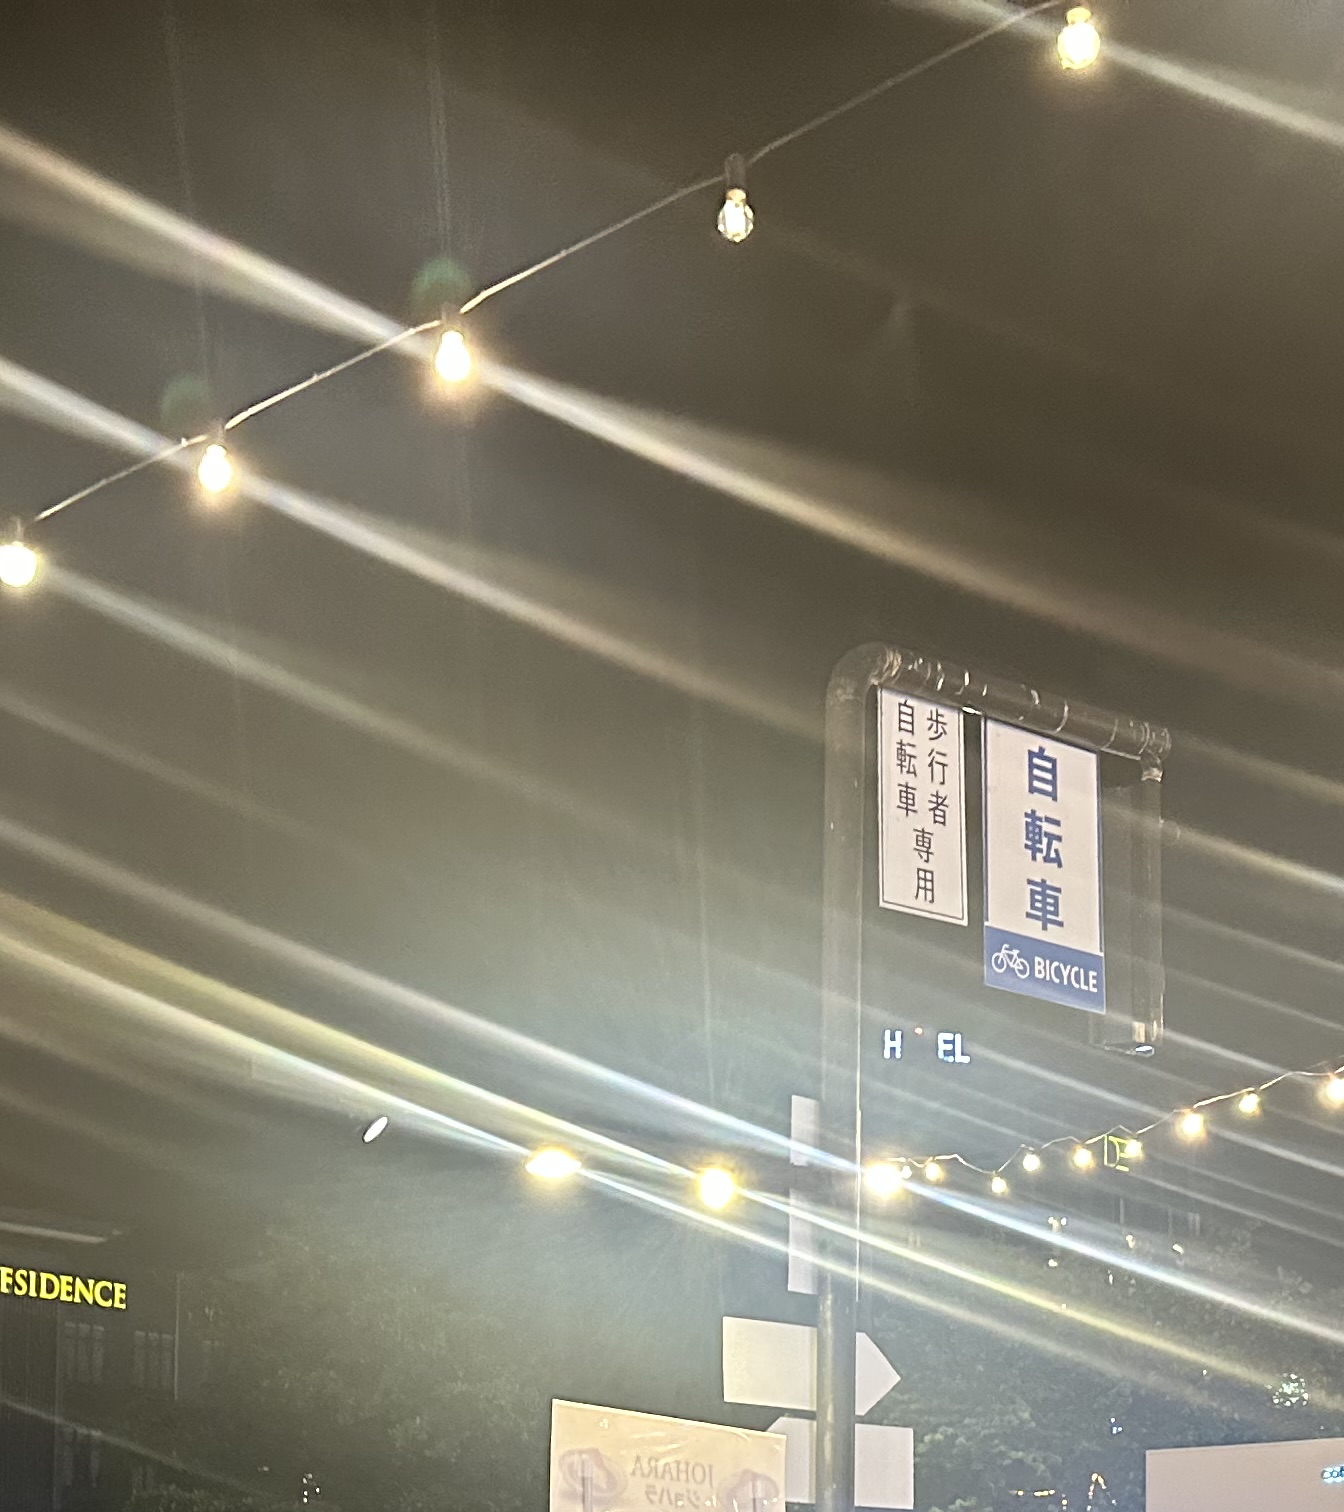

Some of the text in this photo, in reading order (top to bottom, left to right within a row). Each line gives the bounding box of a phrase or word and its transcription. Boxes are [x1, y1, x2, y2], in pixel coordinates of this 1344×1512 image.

[895, 700, 919, 818] 自転車
[925, 708, 950, 827] 歩行者
[913, 828, 935, 904] 専用
[1023, 746, 1065, 932] 自転車
[1034, 956, 1098, 993] BICYCLE
